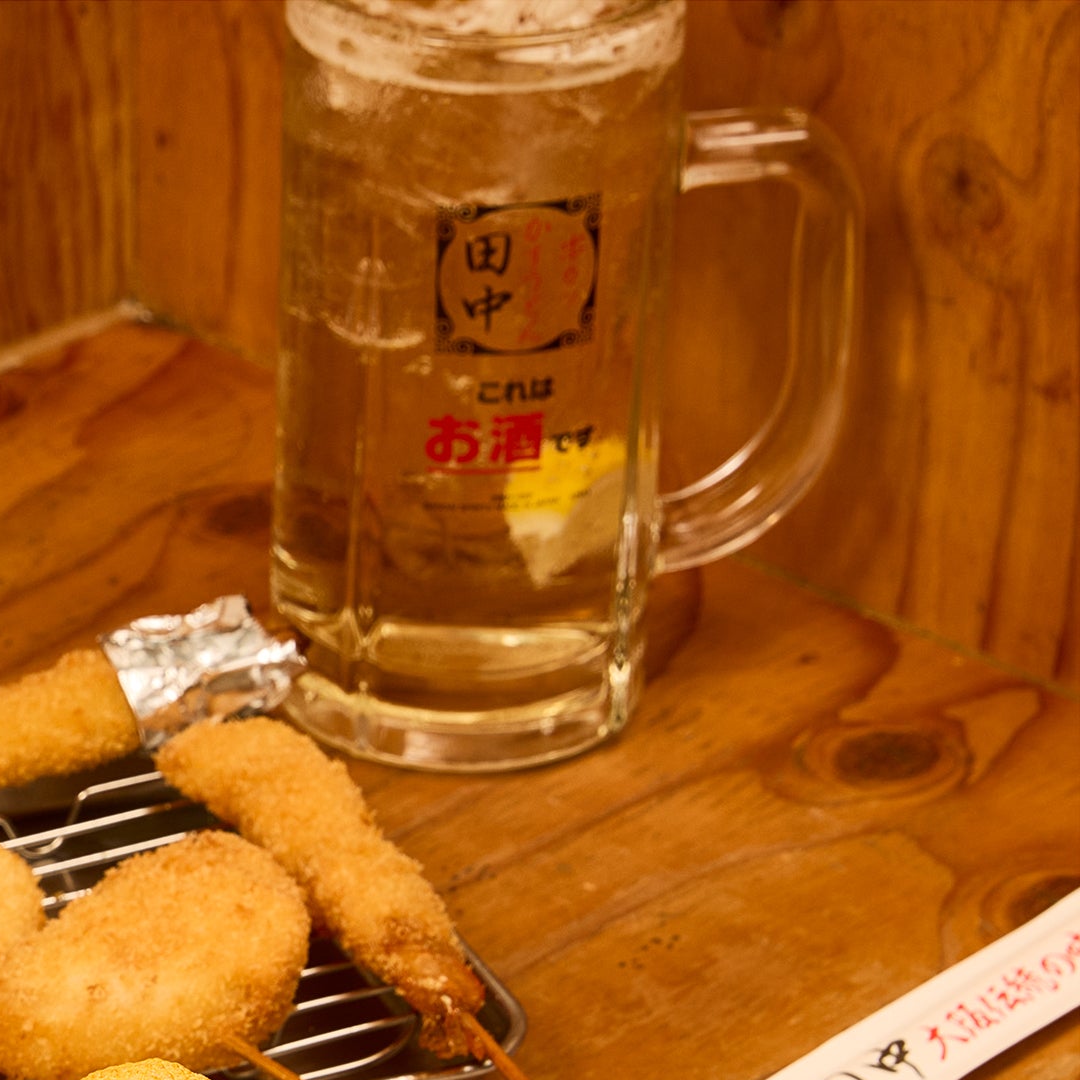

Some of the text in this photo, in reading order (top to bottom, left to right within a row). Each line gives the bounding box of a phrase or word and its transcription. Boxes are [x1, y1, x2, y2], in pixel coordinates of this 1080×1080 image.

[462, 231, 514, 333] 田中
[478, 376, 554, 404] これは
[424, 413, 594, 464] お酒 です
